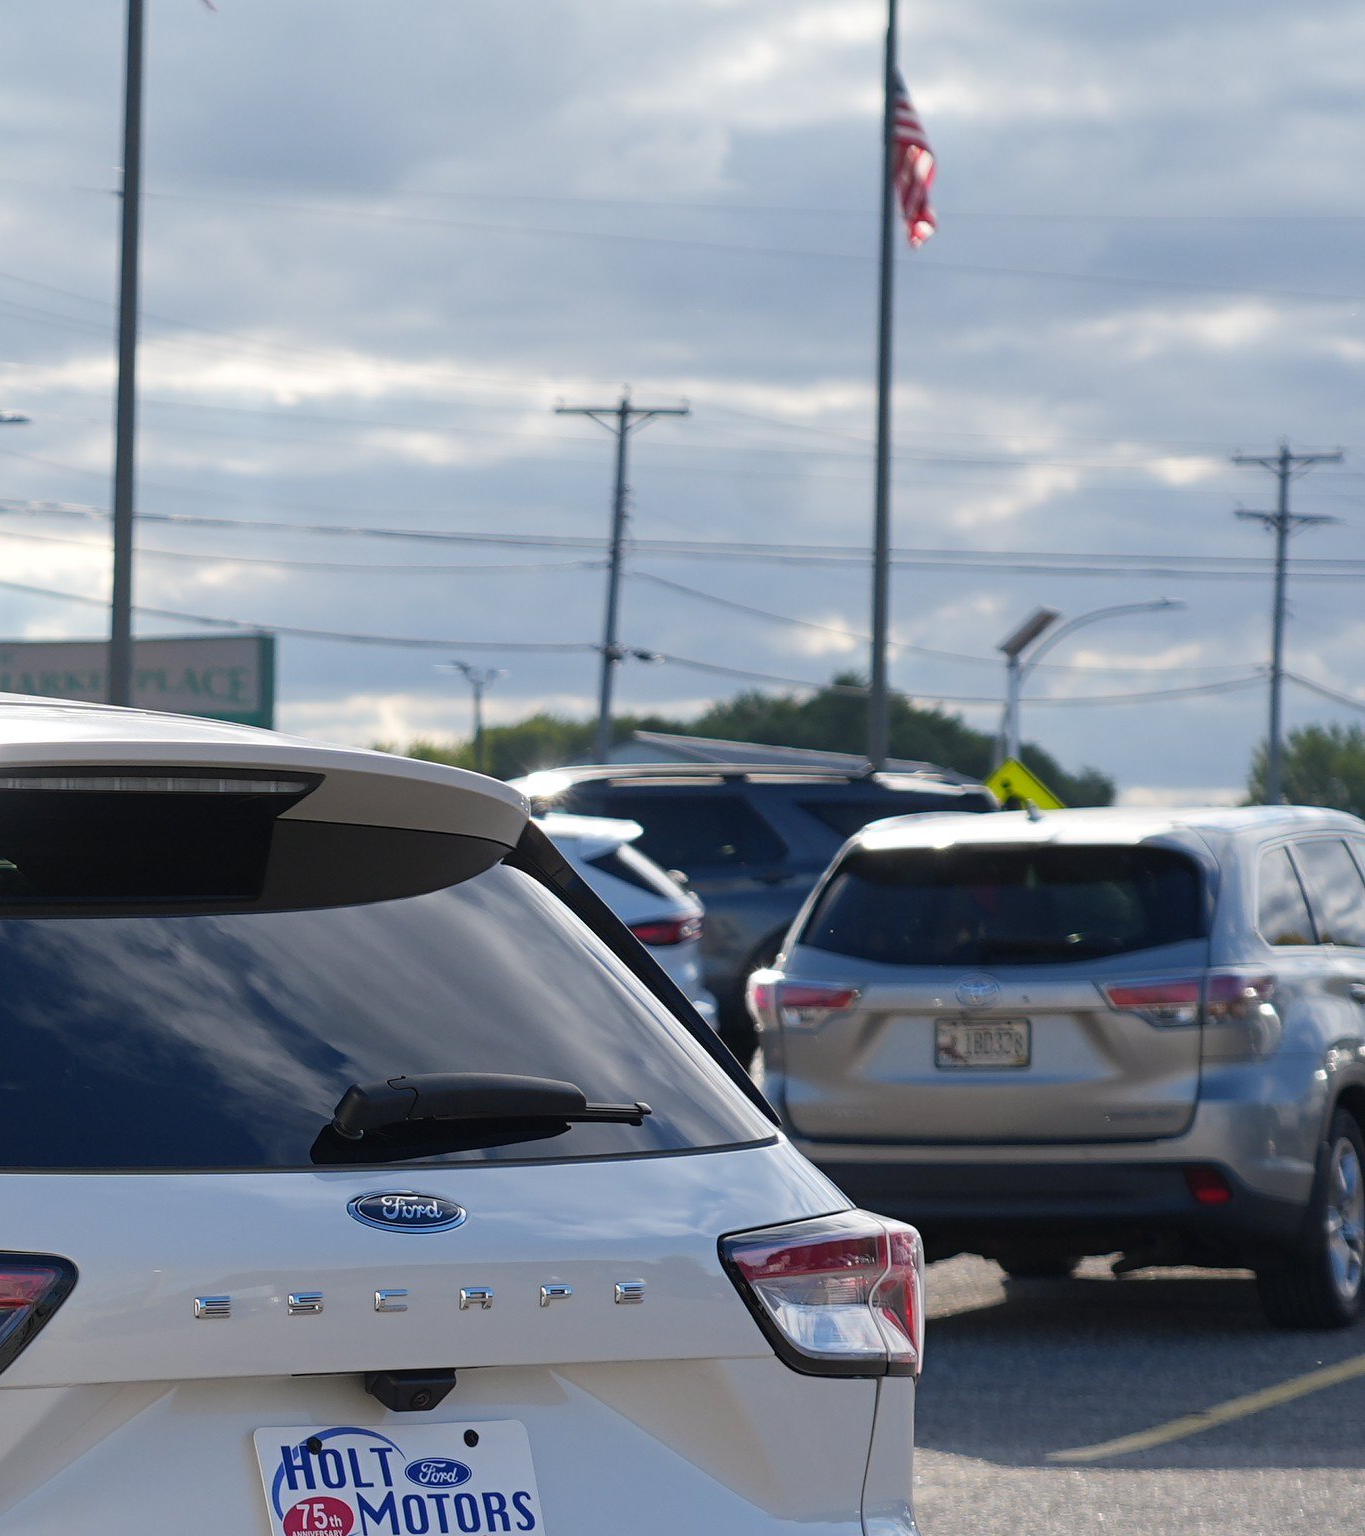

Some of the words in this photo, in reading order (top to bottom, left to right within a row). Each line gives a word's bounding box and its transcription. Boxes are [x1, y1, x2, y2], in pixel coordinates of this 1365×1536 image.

[381, 1195, 443, 1220] Ford
[193, 1281, 646, 1319] ESCAPE
[281, 1445, 393, 1490] HOLT
[419, 1463, 459, 1483] Ford
[296, 1503, 343, 1529] 75th
[356, 1491, 536, 1536] MOTORS
